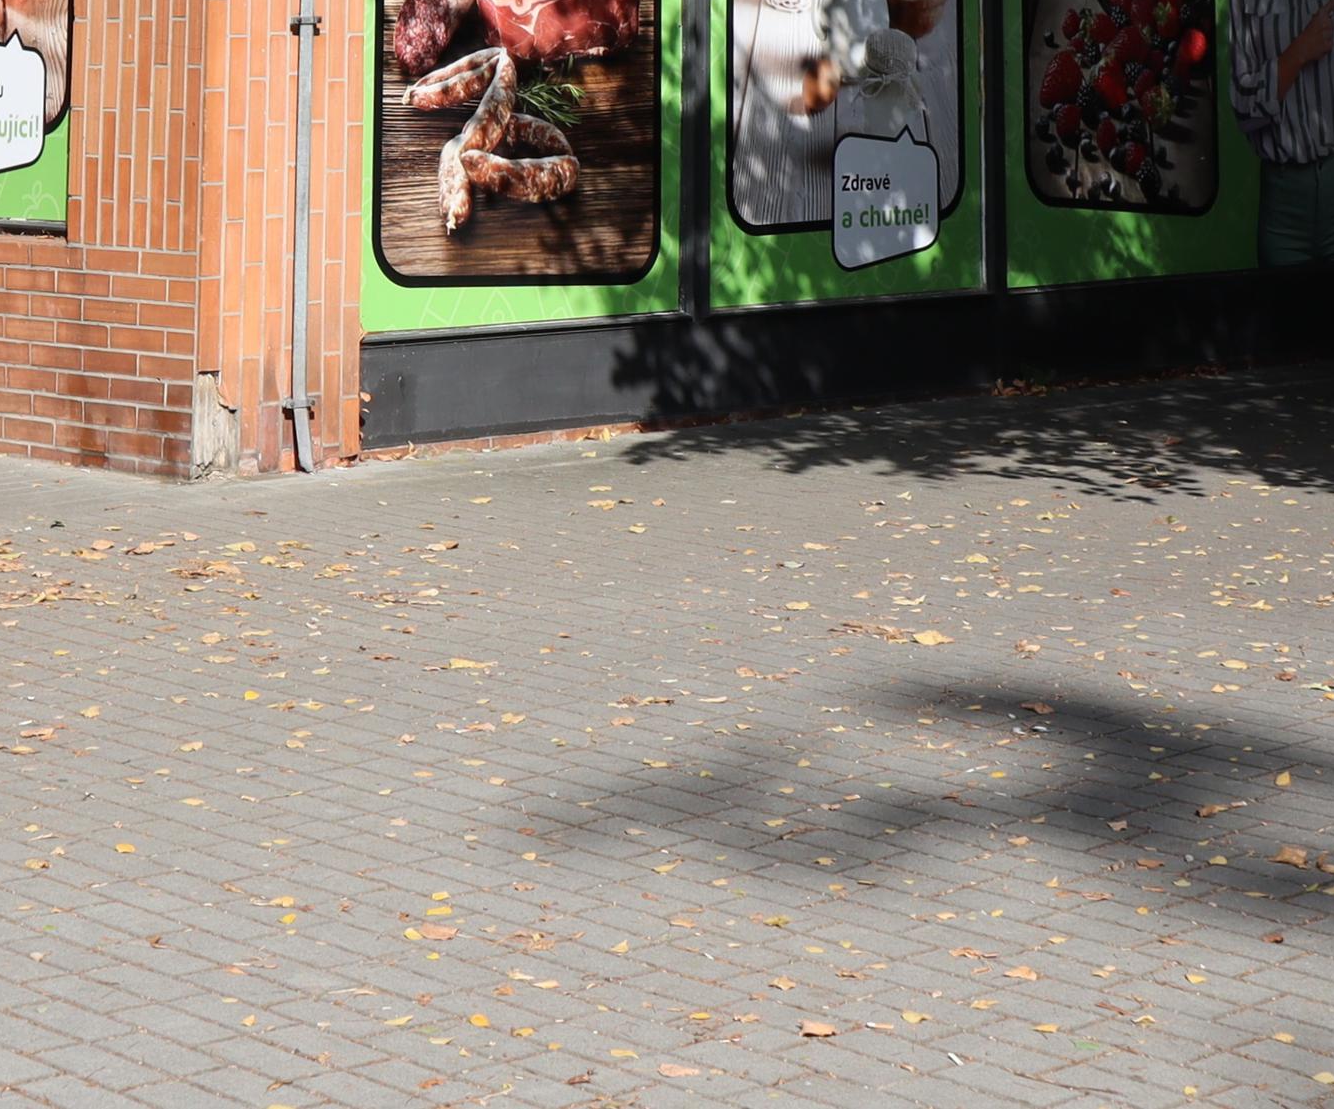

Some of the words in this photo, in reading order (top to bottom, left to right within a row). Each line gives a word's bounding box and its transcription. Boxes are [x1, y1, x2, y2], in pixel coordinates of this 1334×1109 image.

[841, 173, 891, 192] Zdravé
[842, 211, 853, 229] a
[859, 203, 930, 228] chutné!
